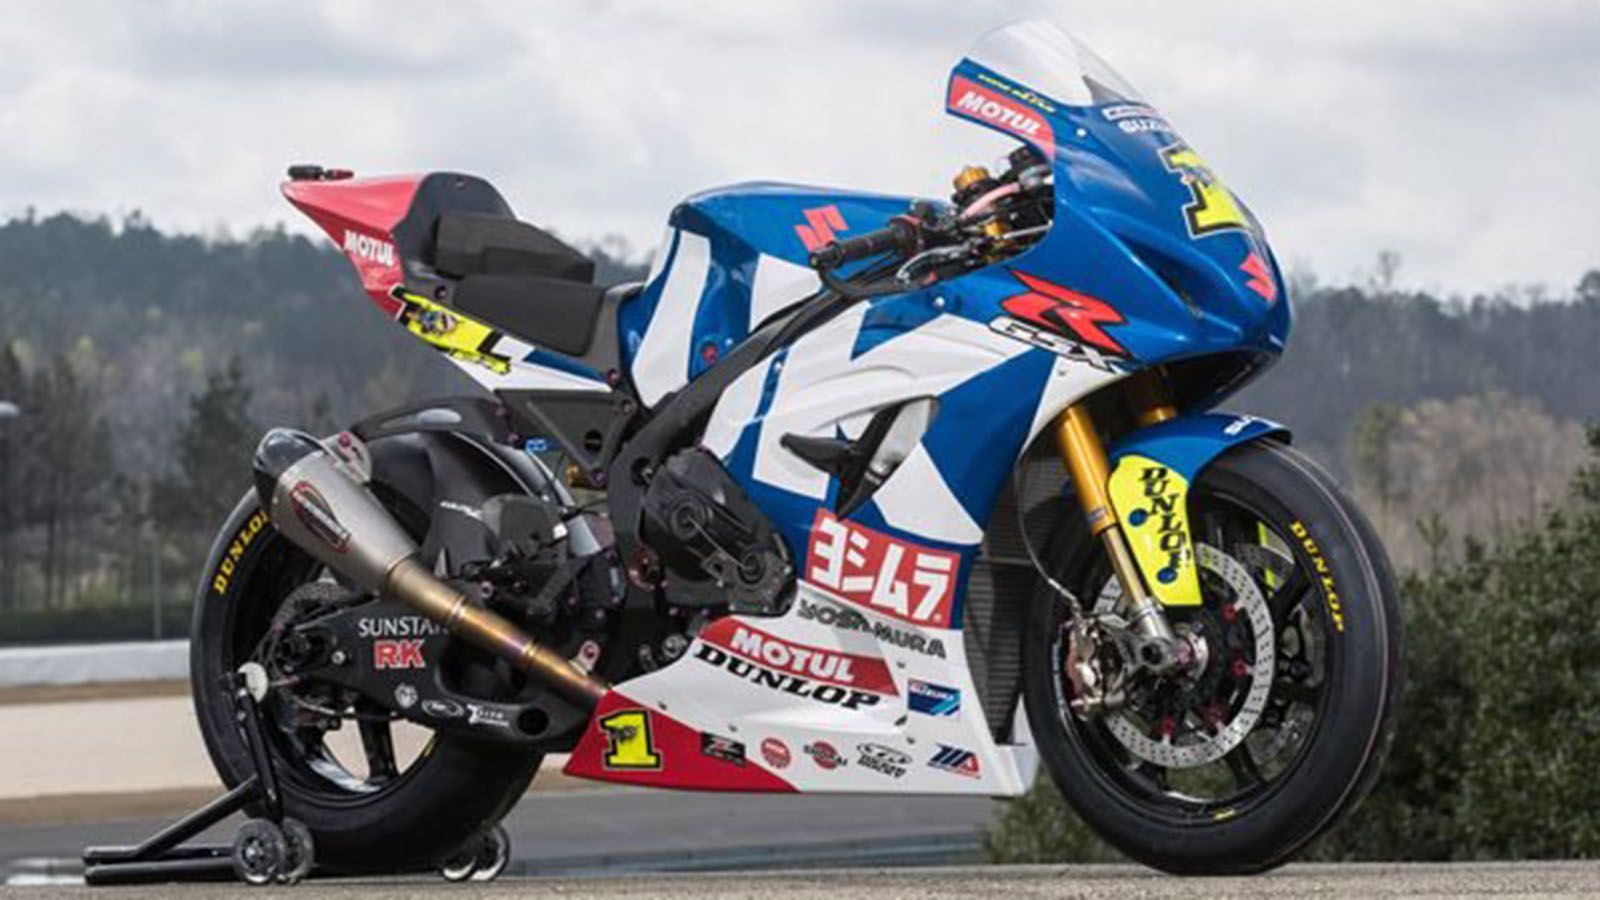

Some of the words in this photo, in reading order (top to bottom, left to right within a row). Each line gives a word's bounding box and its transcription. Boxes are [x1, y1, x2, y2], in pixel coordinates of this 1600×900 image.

[957, 91, 1041, 134] MOTUL
[344, 229, 395, 267] MOTUL
[810, 517, 953, 621] ヨシムラ
[1290, 518, 1344, 634] DUNLOP
[374, 638, 426, 670] RK
[693, 642, 881, 711] DUNLOP
[730, 627, 856, 684] MOTUL
[597, 708, 663, 772] 1
